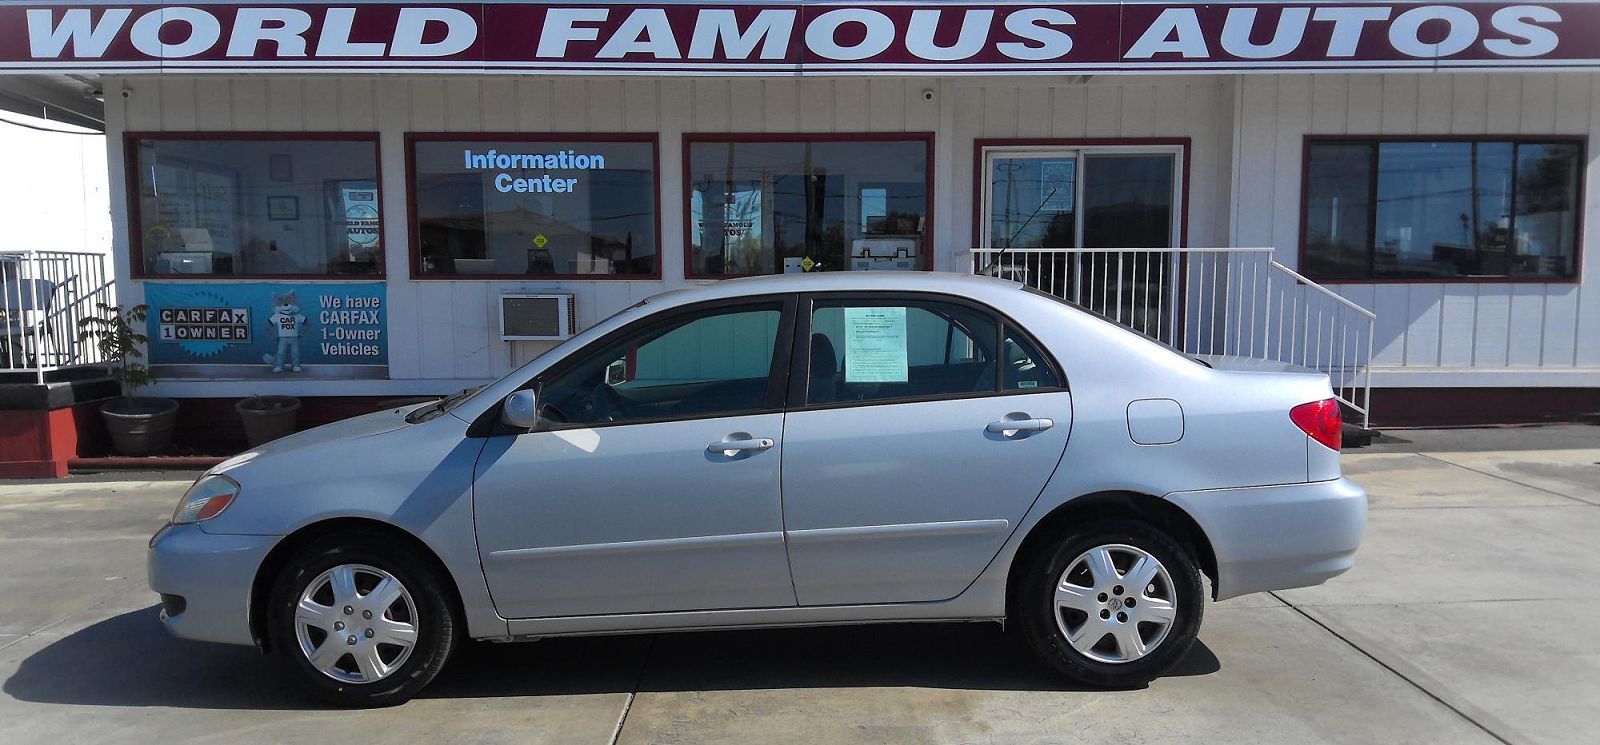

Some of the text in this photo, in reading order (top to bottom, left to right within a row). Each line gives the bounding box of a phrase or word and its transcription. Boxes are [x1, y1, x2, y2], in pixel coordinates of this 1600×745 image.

[26, 5, 1563, 61] WORLD FAMOUS AUTOS
[464, 149, 606, 170] Information
[494, 172, 578, 194] Center
[319, 295, 380, 308] We have
[161, 310, 246, 324] CARFAX
[320, 310, 380, 325] CARFAX
[321, 327, 381, 340] 1-Owner
[320, 342, 379, 356] Vehicles
